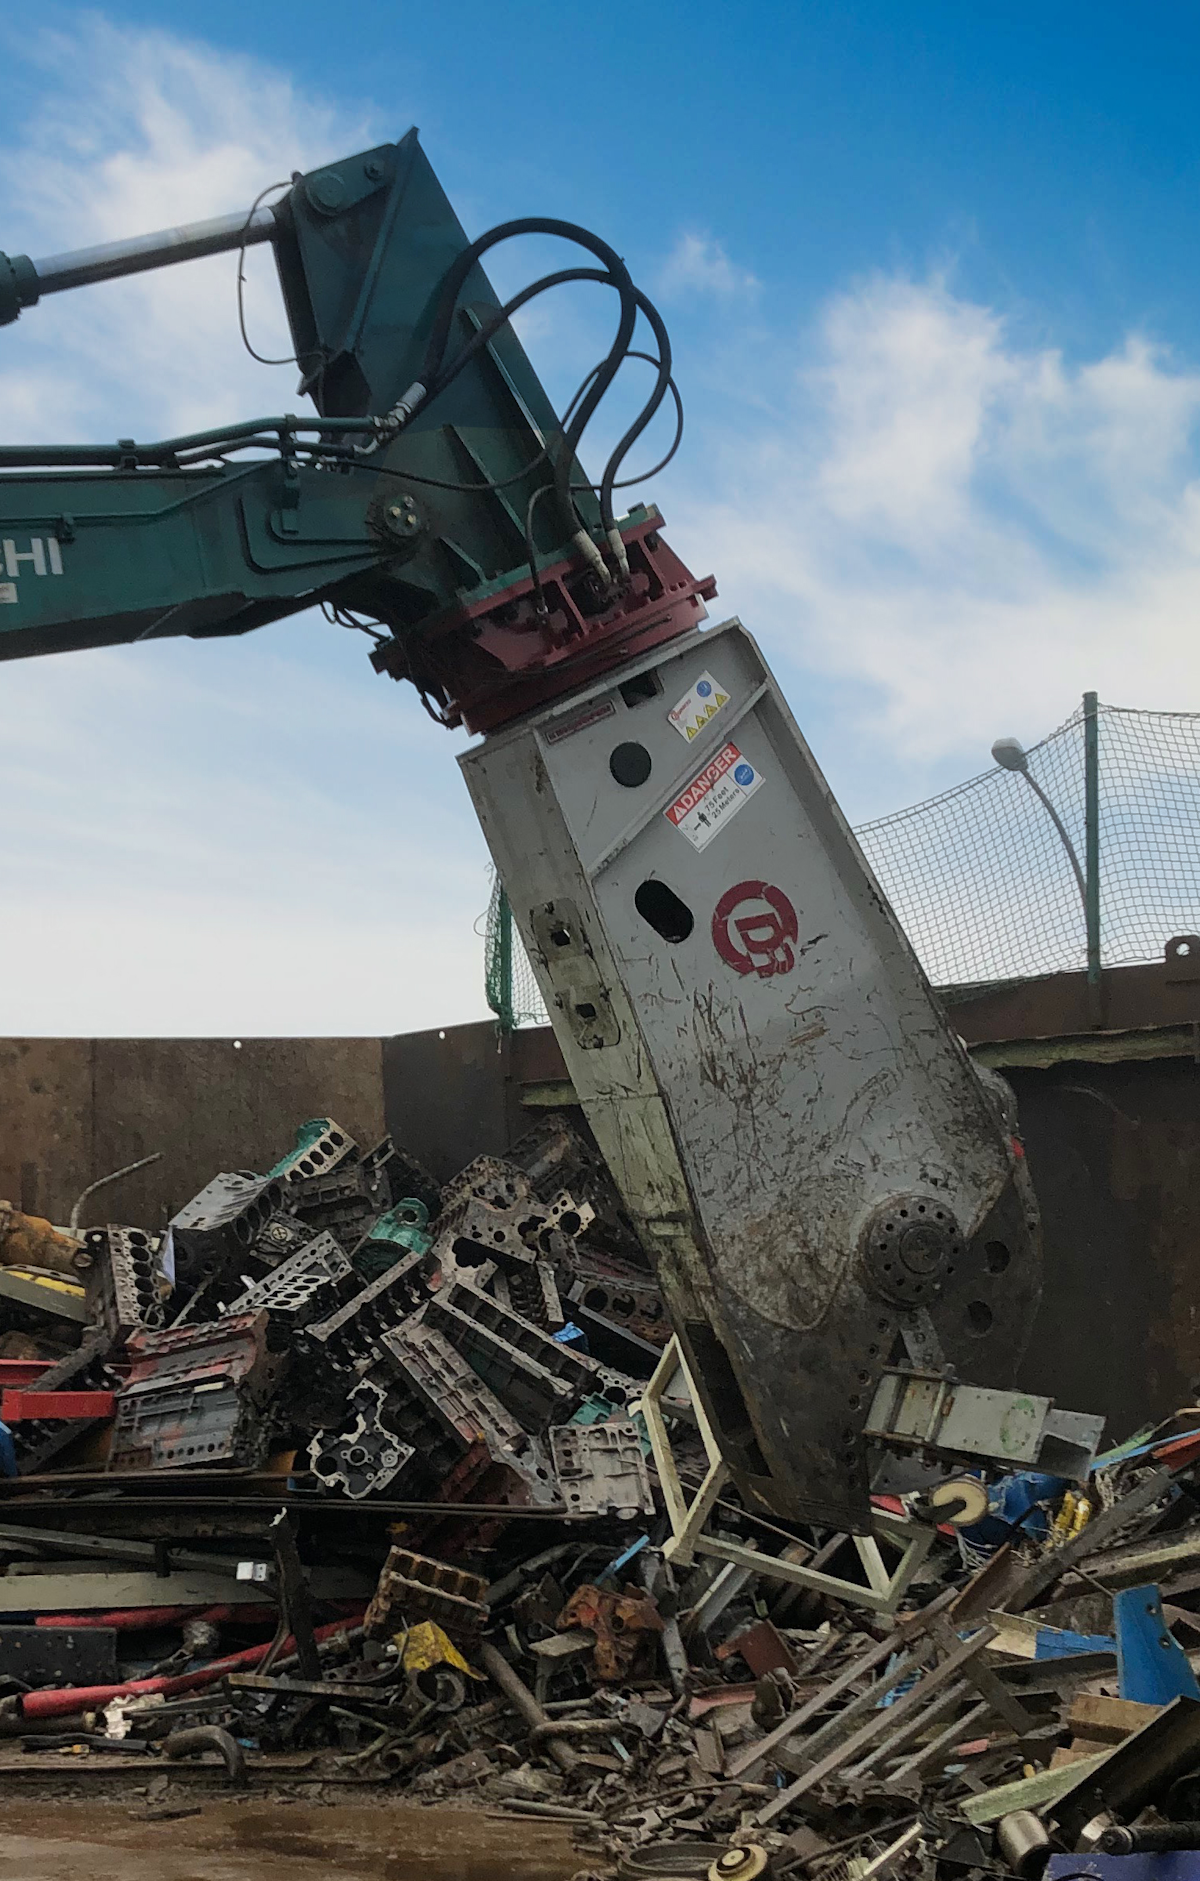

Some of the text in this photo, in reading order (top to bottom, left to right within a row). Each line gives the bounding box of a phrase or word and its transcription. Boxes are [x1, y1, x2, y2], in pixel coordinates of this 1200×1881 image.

[0, 537, 64, 578] HI
[680, 748, 737, 810] DANGER
[704, 786, 729, 812] 75 Feet
[711, 788, 740, 819] 25 Meters
